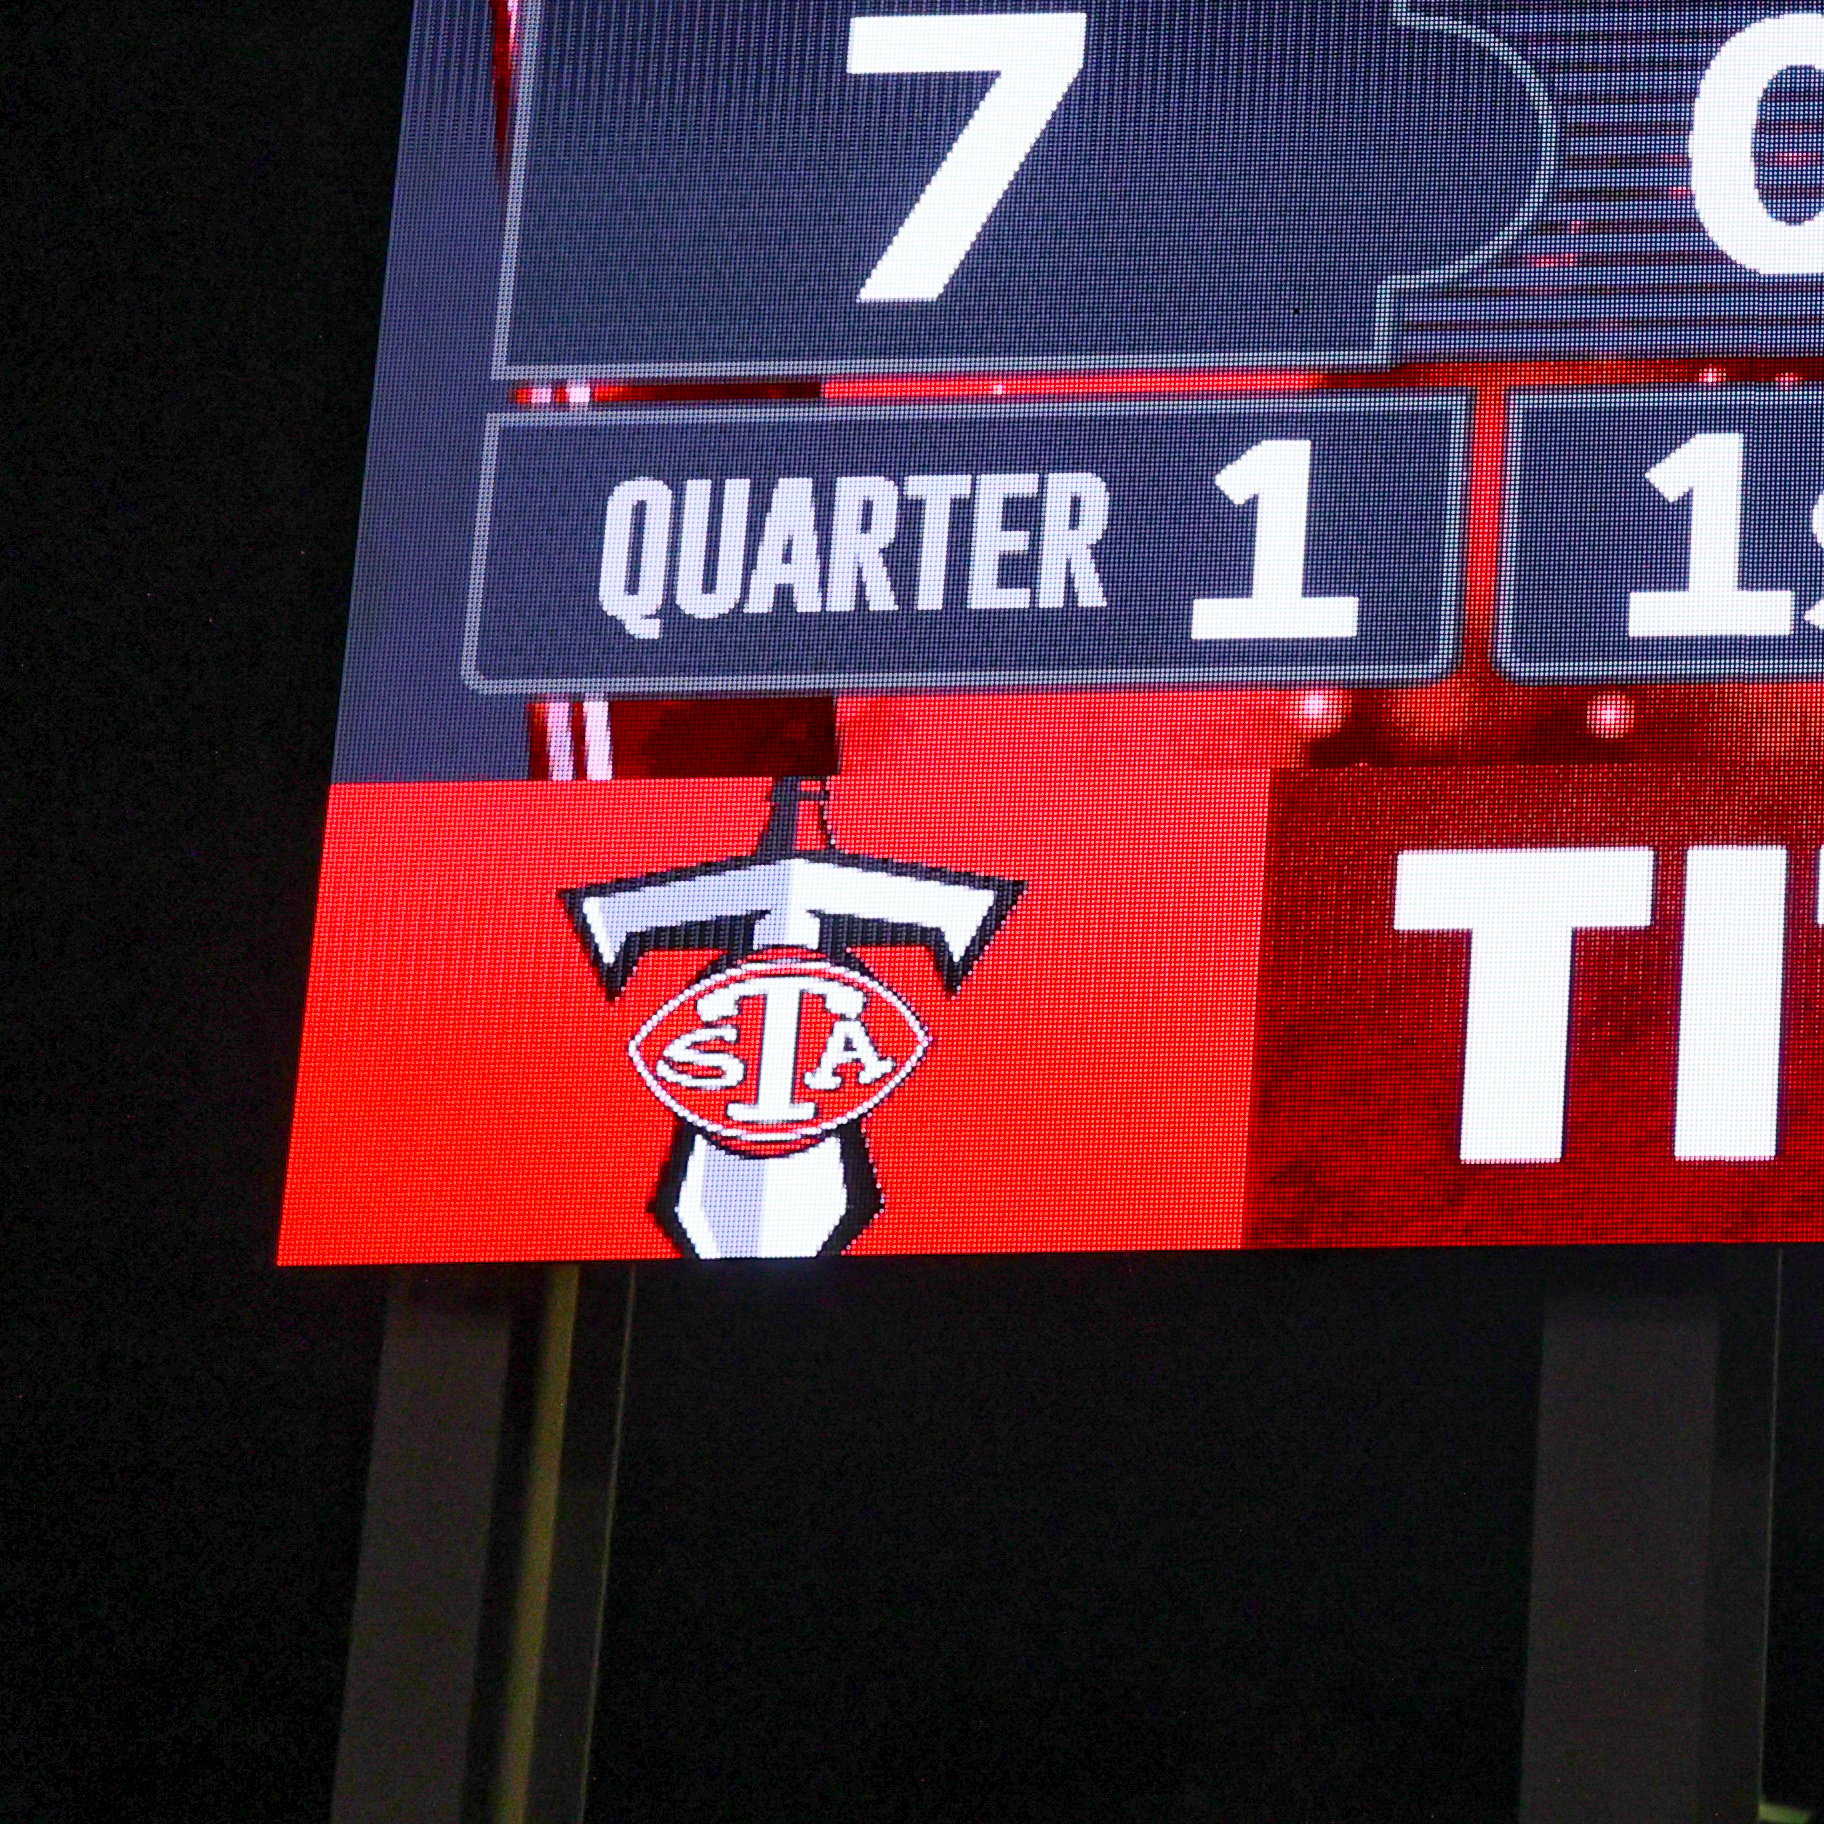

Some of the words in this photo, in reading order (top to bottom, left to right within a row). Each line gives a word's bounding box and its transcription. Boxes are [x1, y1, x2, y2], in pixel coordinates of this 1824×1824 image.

[844, 11, 1088, 304] 7
[596, 471, 1110, 640] QUARTER
[1190, 436, 1360, 641] 1
